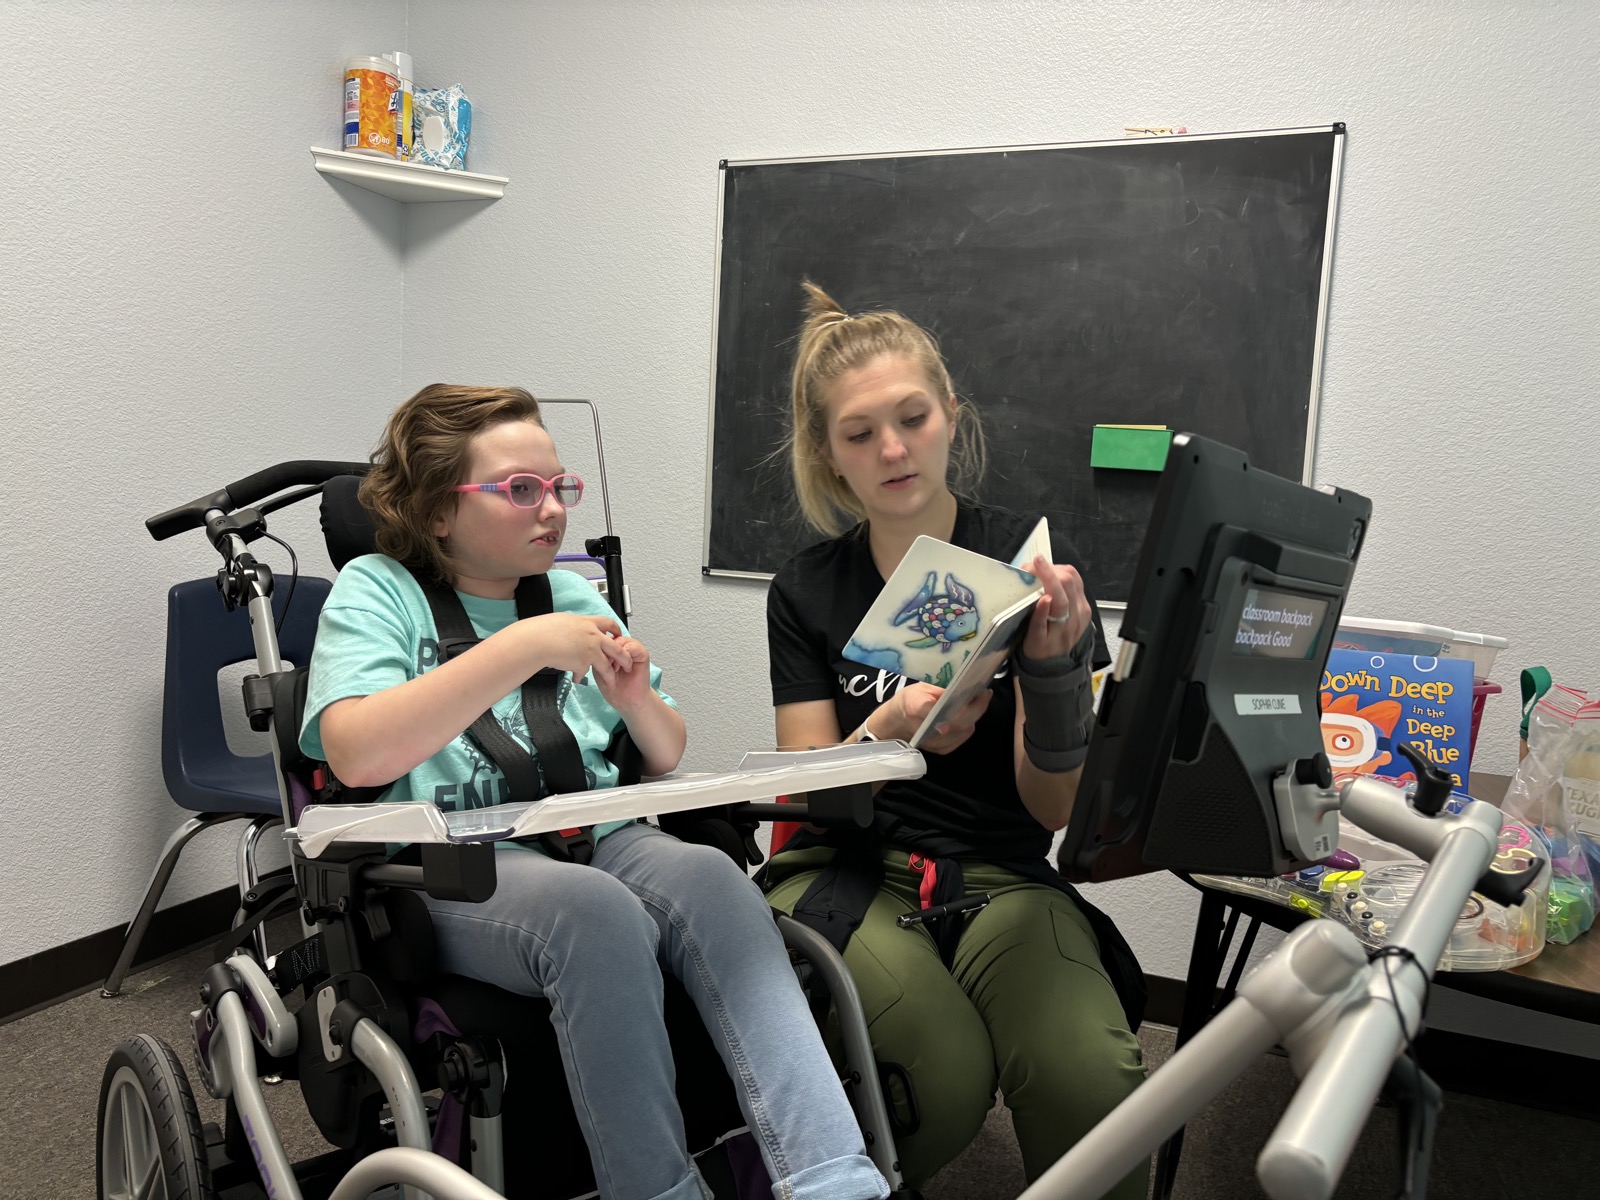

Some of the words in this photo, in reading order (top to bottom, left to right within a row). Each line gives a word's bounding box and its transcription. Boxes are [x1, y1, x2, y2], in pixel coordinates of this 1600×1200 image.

[1242, 603, 1281, 623] classroom
[1281, 608, 1313, 629] backpack
[1235, 629, 1272, 648] backpack
[1272, 631, 1293, 647] Good
[1388, 675, 1454, 704] Deep
[1412, 705, 1424, 715] in
[1426, 707, 1445, 718] the
[1406, 718, 1456, 741] Deep
[1410, 739, 1460, 764] Blue
